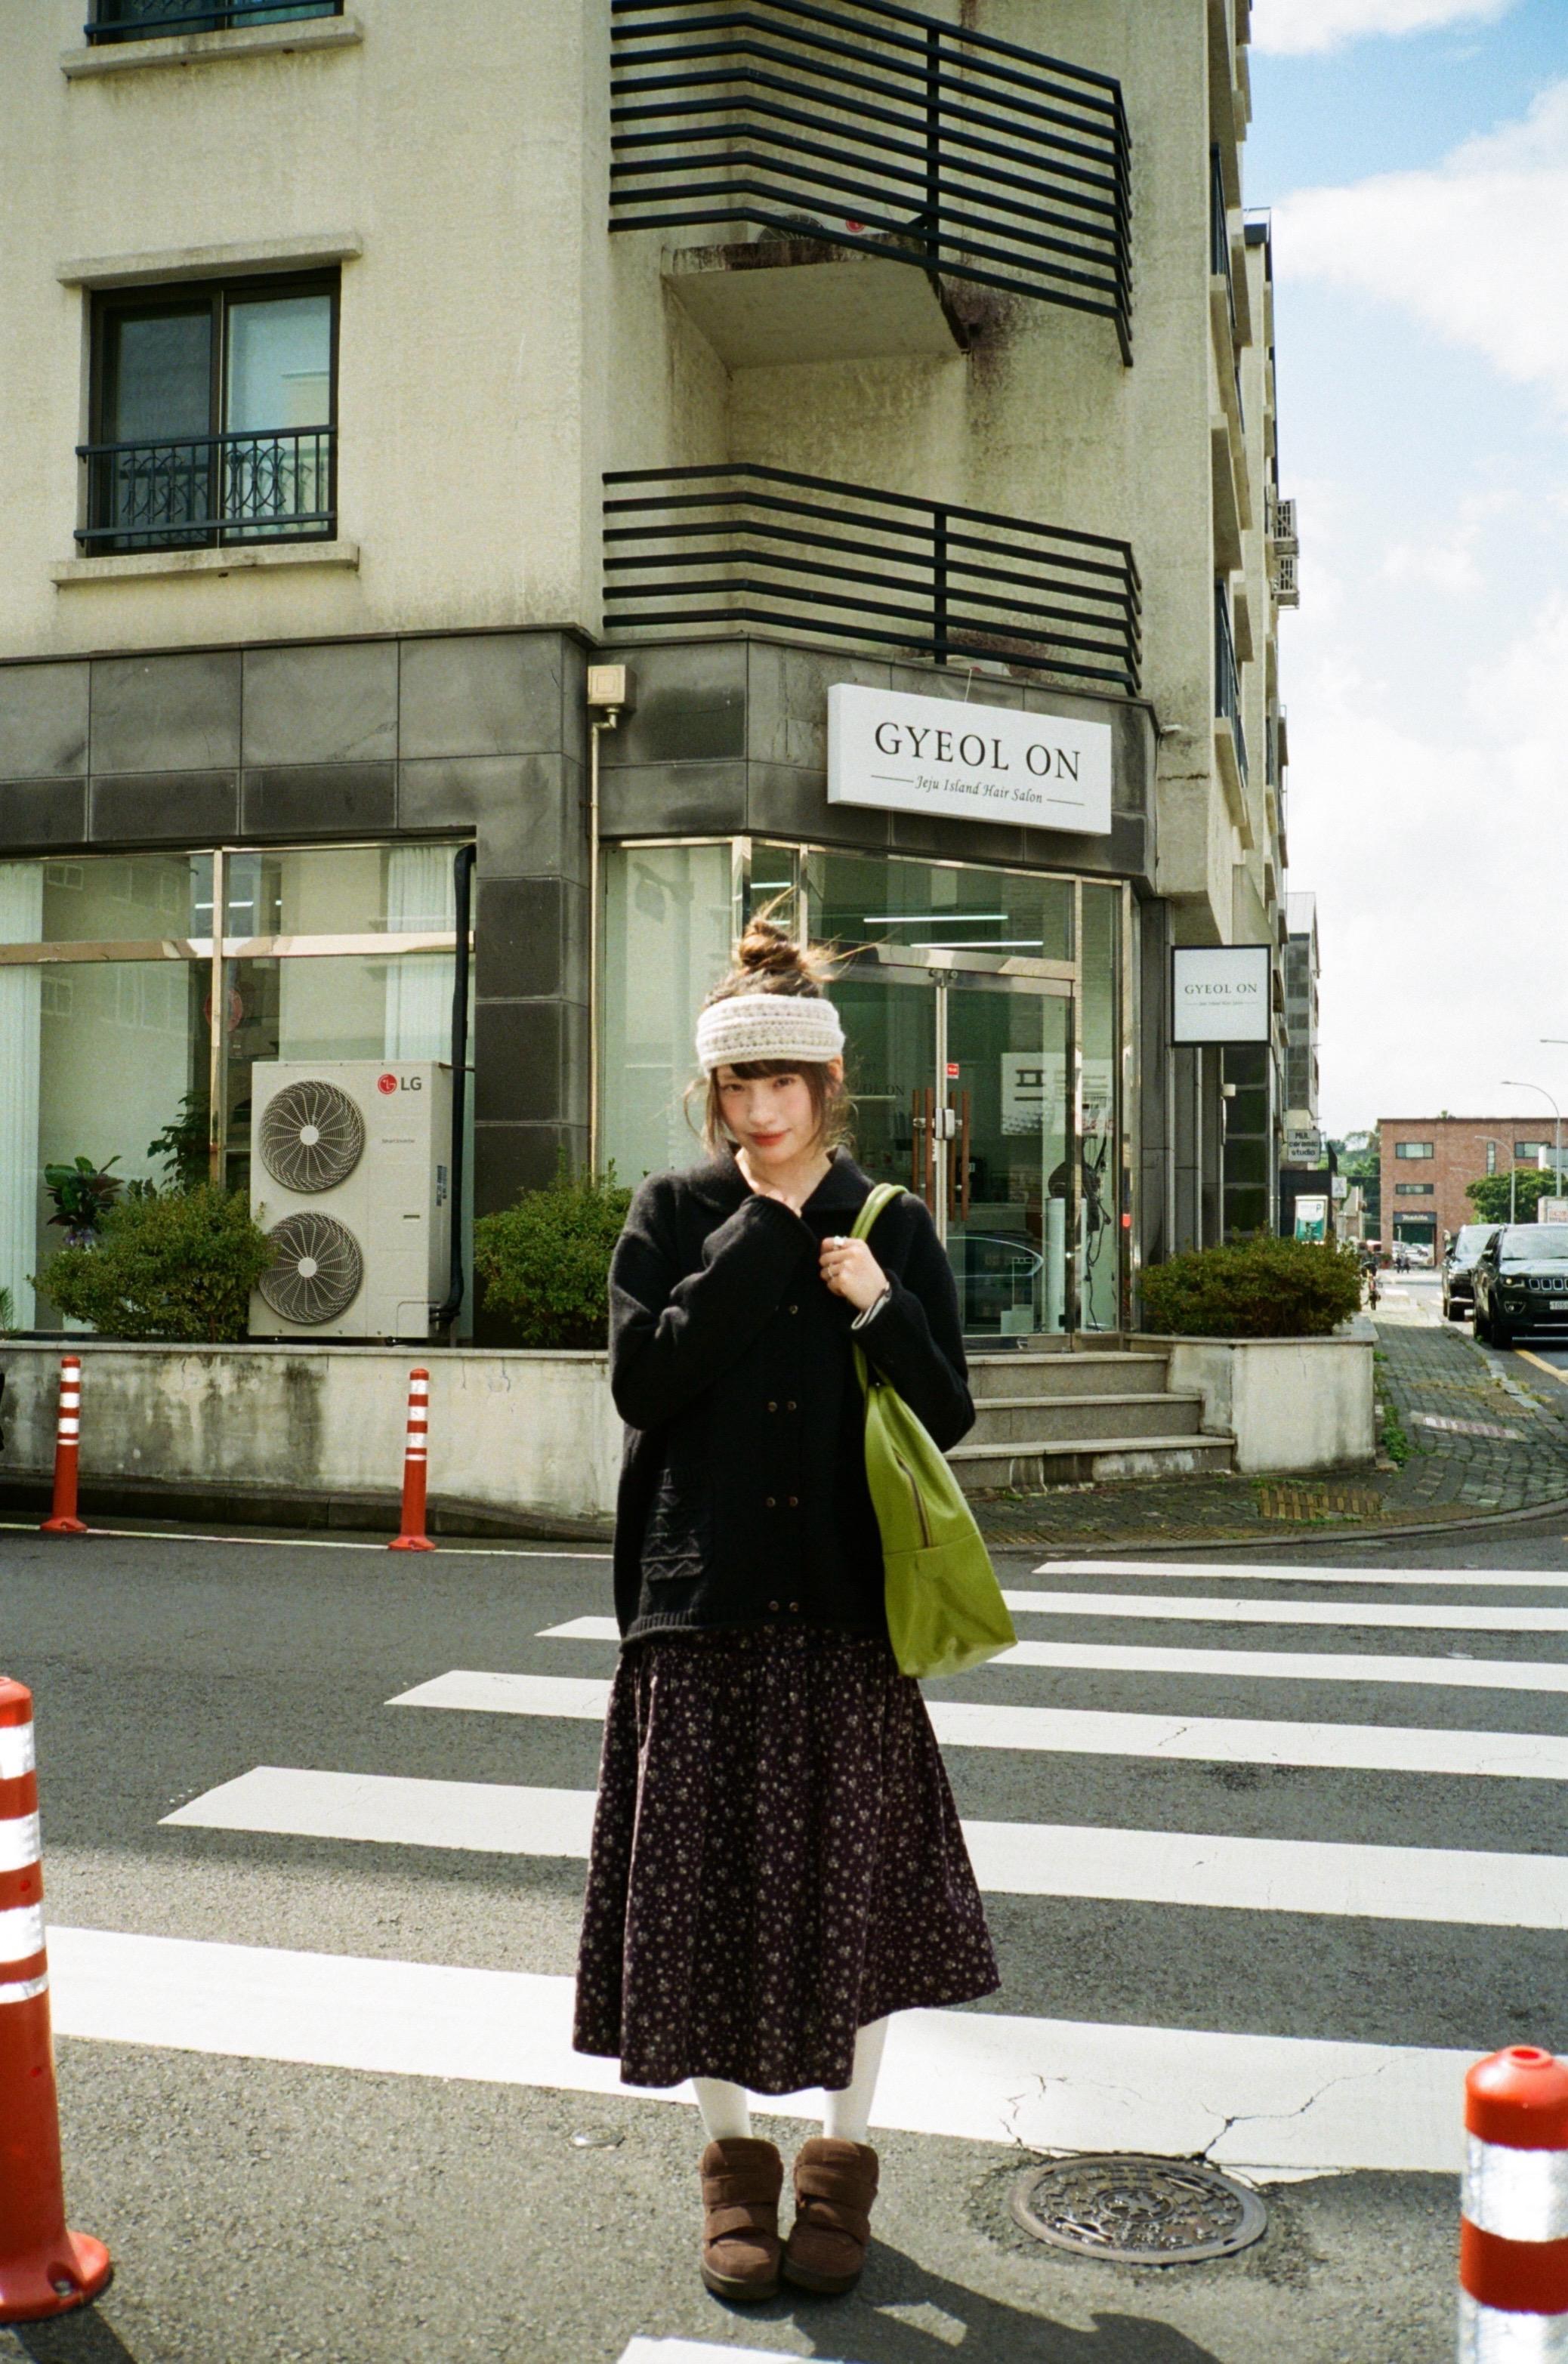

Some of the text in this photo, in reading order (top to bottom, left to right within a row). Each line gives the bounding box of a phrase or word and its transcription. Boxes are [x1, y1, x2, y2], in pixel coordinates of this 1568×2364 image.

[875, 722, 1081, 782] GYEOL ON
[915, 776, 1042, 804] Jeju Island Hair Salon
[1184, 983, 1258, 995] GYEOL ON
[401, 1077, 421, 1091] LG
